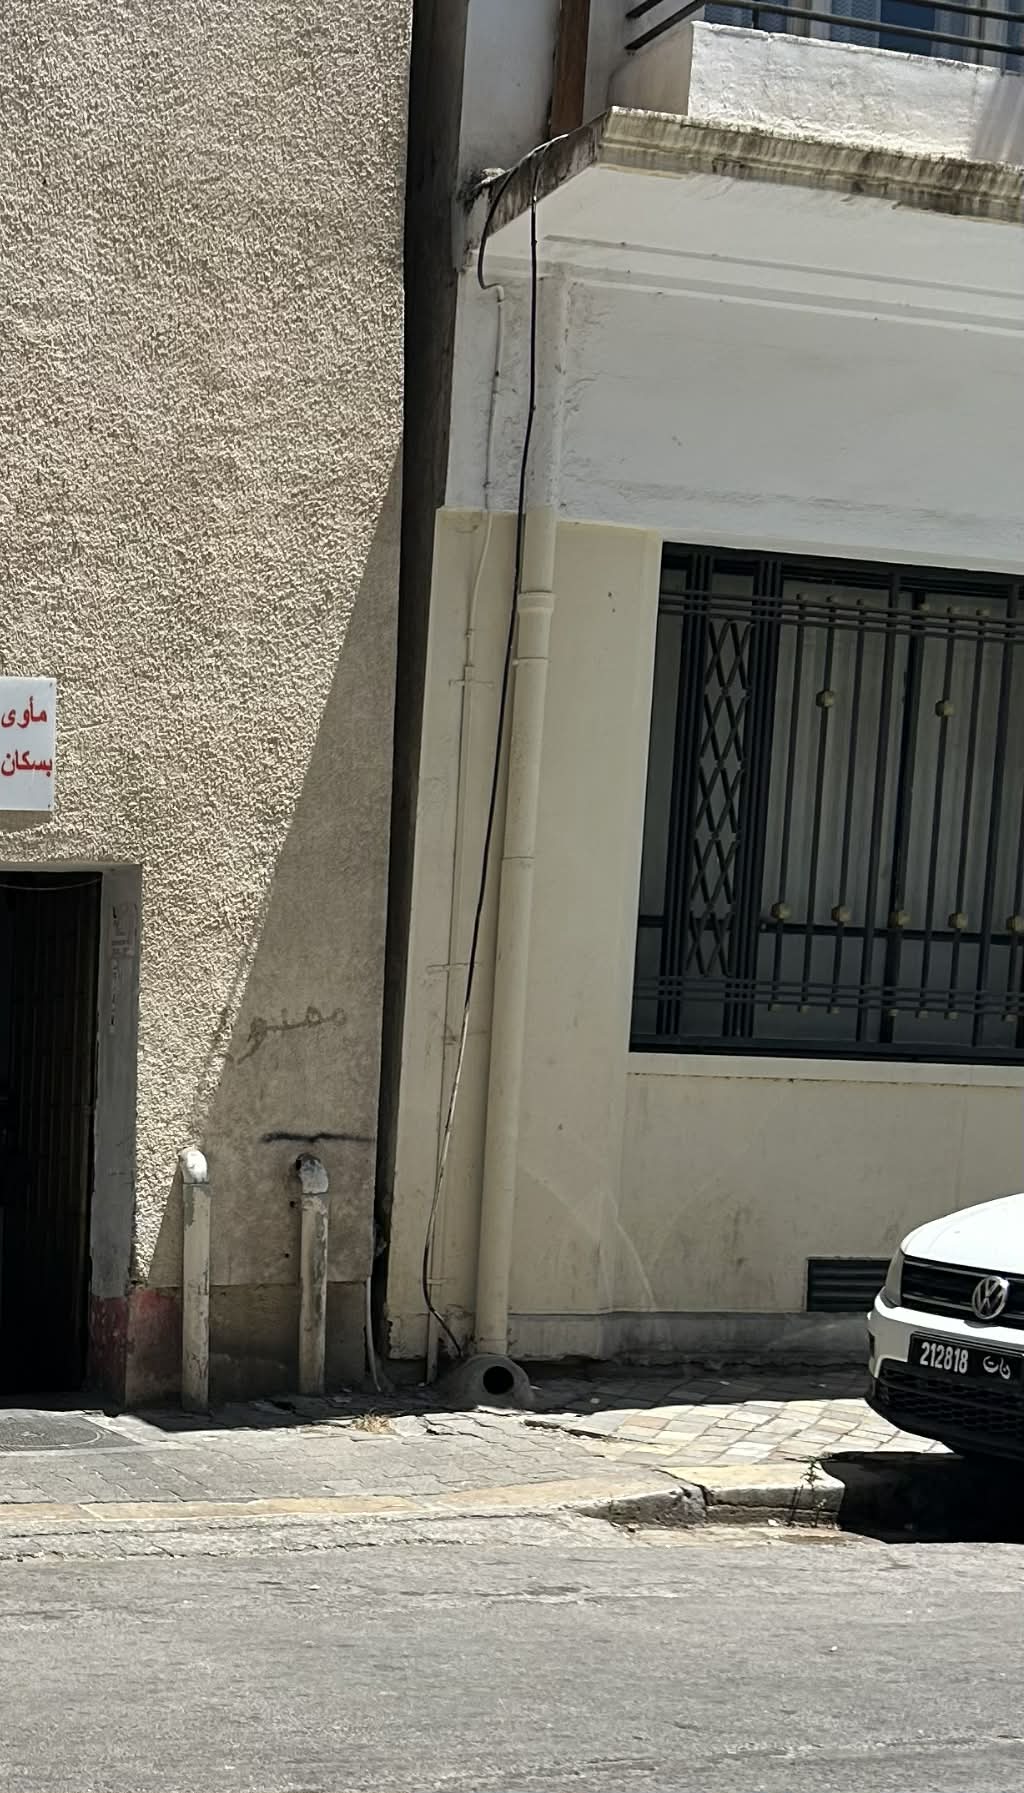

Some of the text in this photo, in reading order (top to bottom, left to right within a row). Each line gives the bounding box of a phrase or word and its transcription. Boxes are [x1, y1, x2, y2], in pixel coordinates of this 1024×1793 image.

[1, 696, 48, 729] مأوى
[1, 749, 53, 777] بسكان
[920, 1342, 968, 1373] 212818
